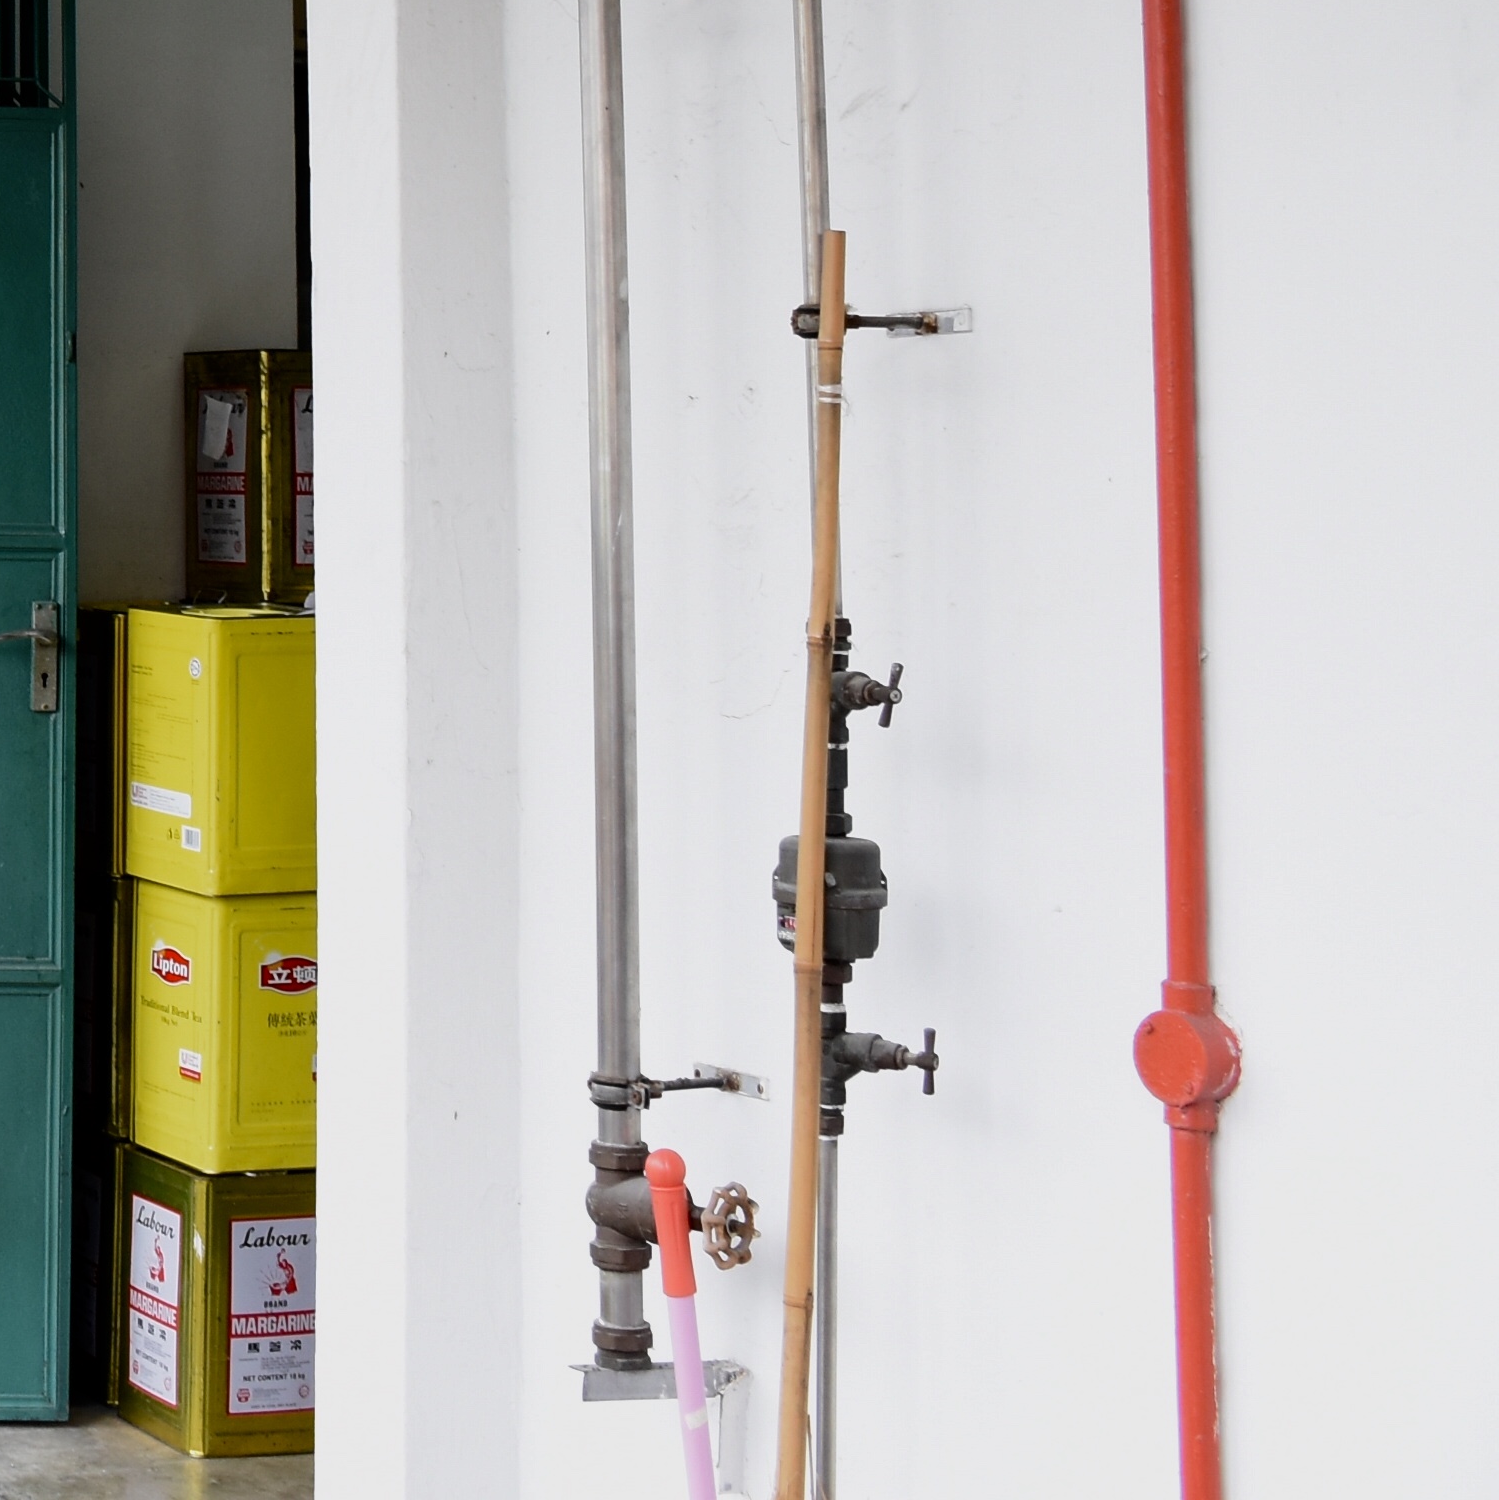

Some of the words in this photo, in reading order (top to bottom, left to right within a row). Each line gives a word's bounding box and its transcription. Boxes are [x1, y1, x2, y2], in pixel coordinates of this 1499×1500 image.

[197, 475, 246, 492] MARGARINE
[153, 952, 188, 978] Lipton
[141, 995, 170, 1014] Traditional
[171, 1005, 189, 1021] Blend
[191, 1011, 203, 1024] Tea
[136, 1206, 175, 1239] Labour
[239, 1227, 311, 1248] Labour
[130, 1289, 177, 1327] MARGARINE
[263, 1300, 288, 1309] BRAND
[232, 1313, 316, 1335] MARGARINE
[258, 1373, 287, 1382] CONTENT
